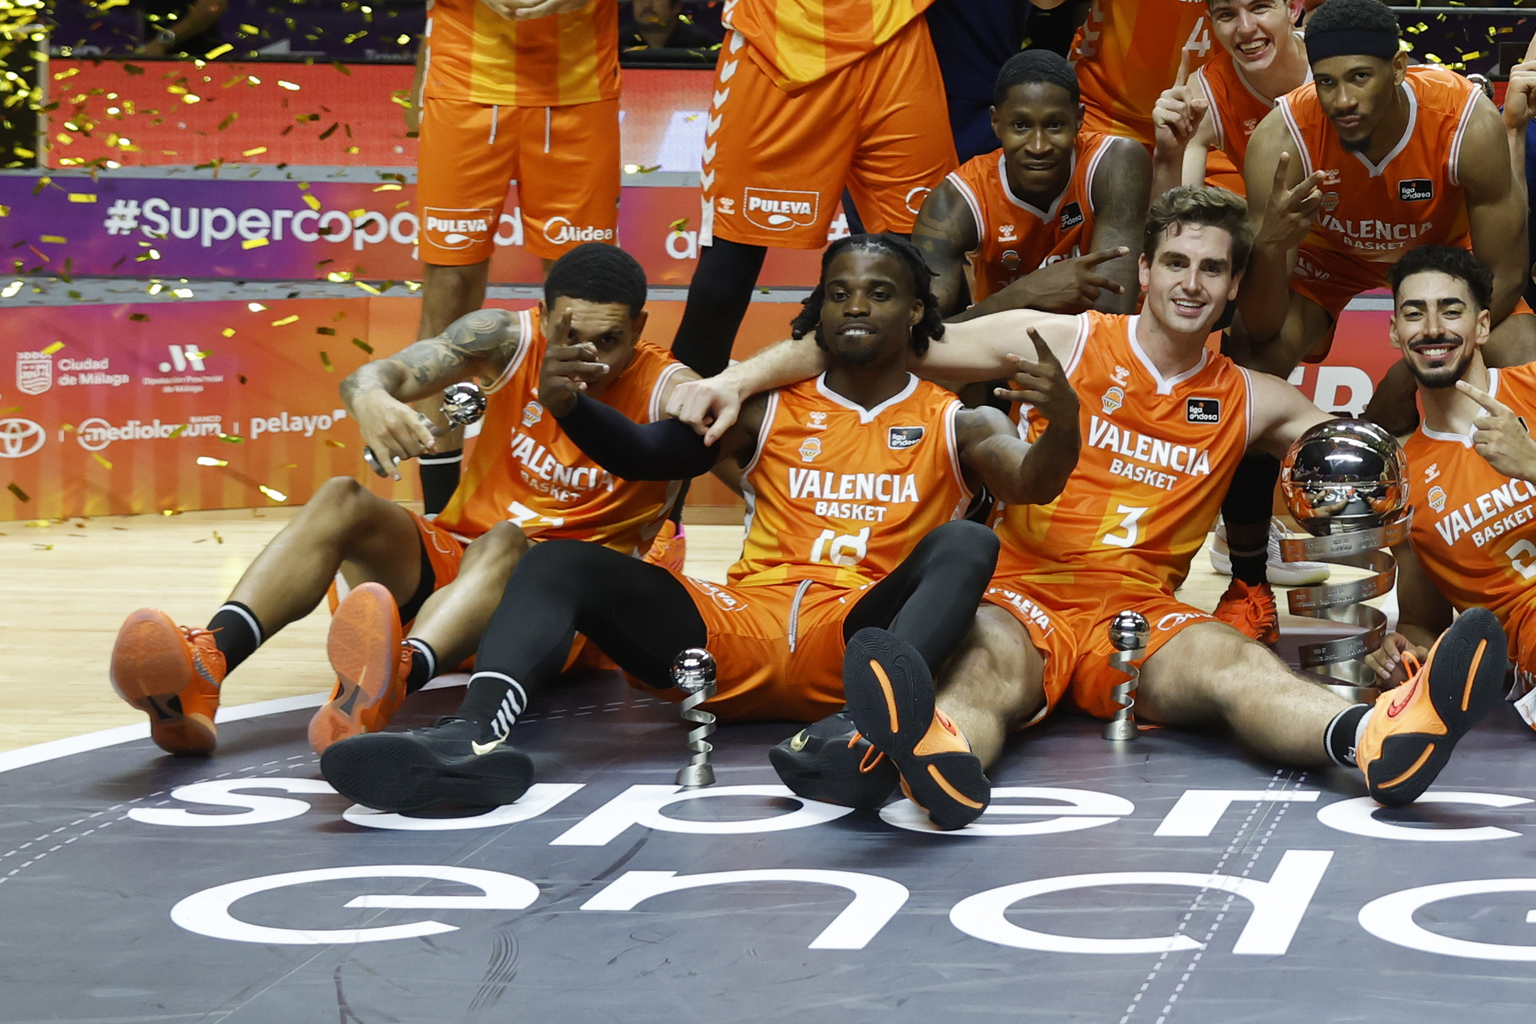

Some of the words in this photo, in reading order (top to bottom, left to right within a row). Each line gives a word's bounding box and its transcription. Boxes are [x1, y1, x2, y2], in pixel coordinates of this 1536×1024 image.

[1184, 17, 1211, 57] 4
[748, 198, 812, 215] PULEVA
[427, 215, 489, 233] PULEVA
[560, 225, 613, 242] Midea
[1317, 214, 1433, 240] VALENCIA
[1343, 236, 1407, 251] BASKET
[58, 357, 109, 371] Ciudad
[58, 374, 77, 385] de
[79, 371, 130, 387] Málaga
[86, 419, 222, 442] mediolanum
[251, 411, 332, 439] pelayo
[1088, 415, 1211, 476] VALENCIA
[511, 427, 614, 492] VALENCIA
[788, 467, 920, 503] VALENCIA
[1109, 458, 1178, 491] BASKET
[815, 501, 887, 522] BASKET
[1102, 505, 1149, 548] 3
[1471, 504, 1535, 548] BASKET
